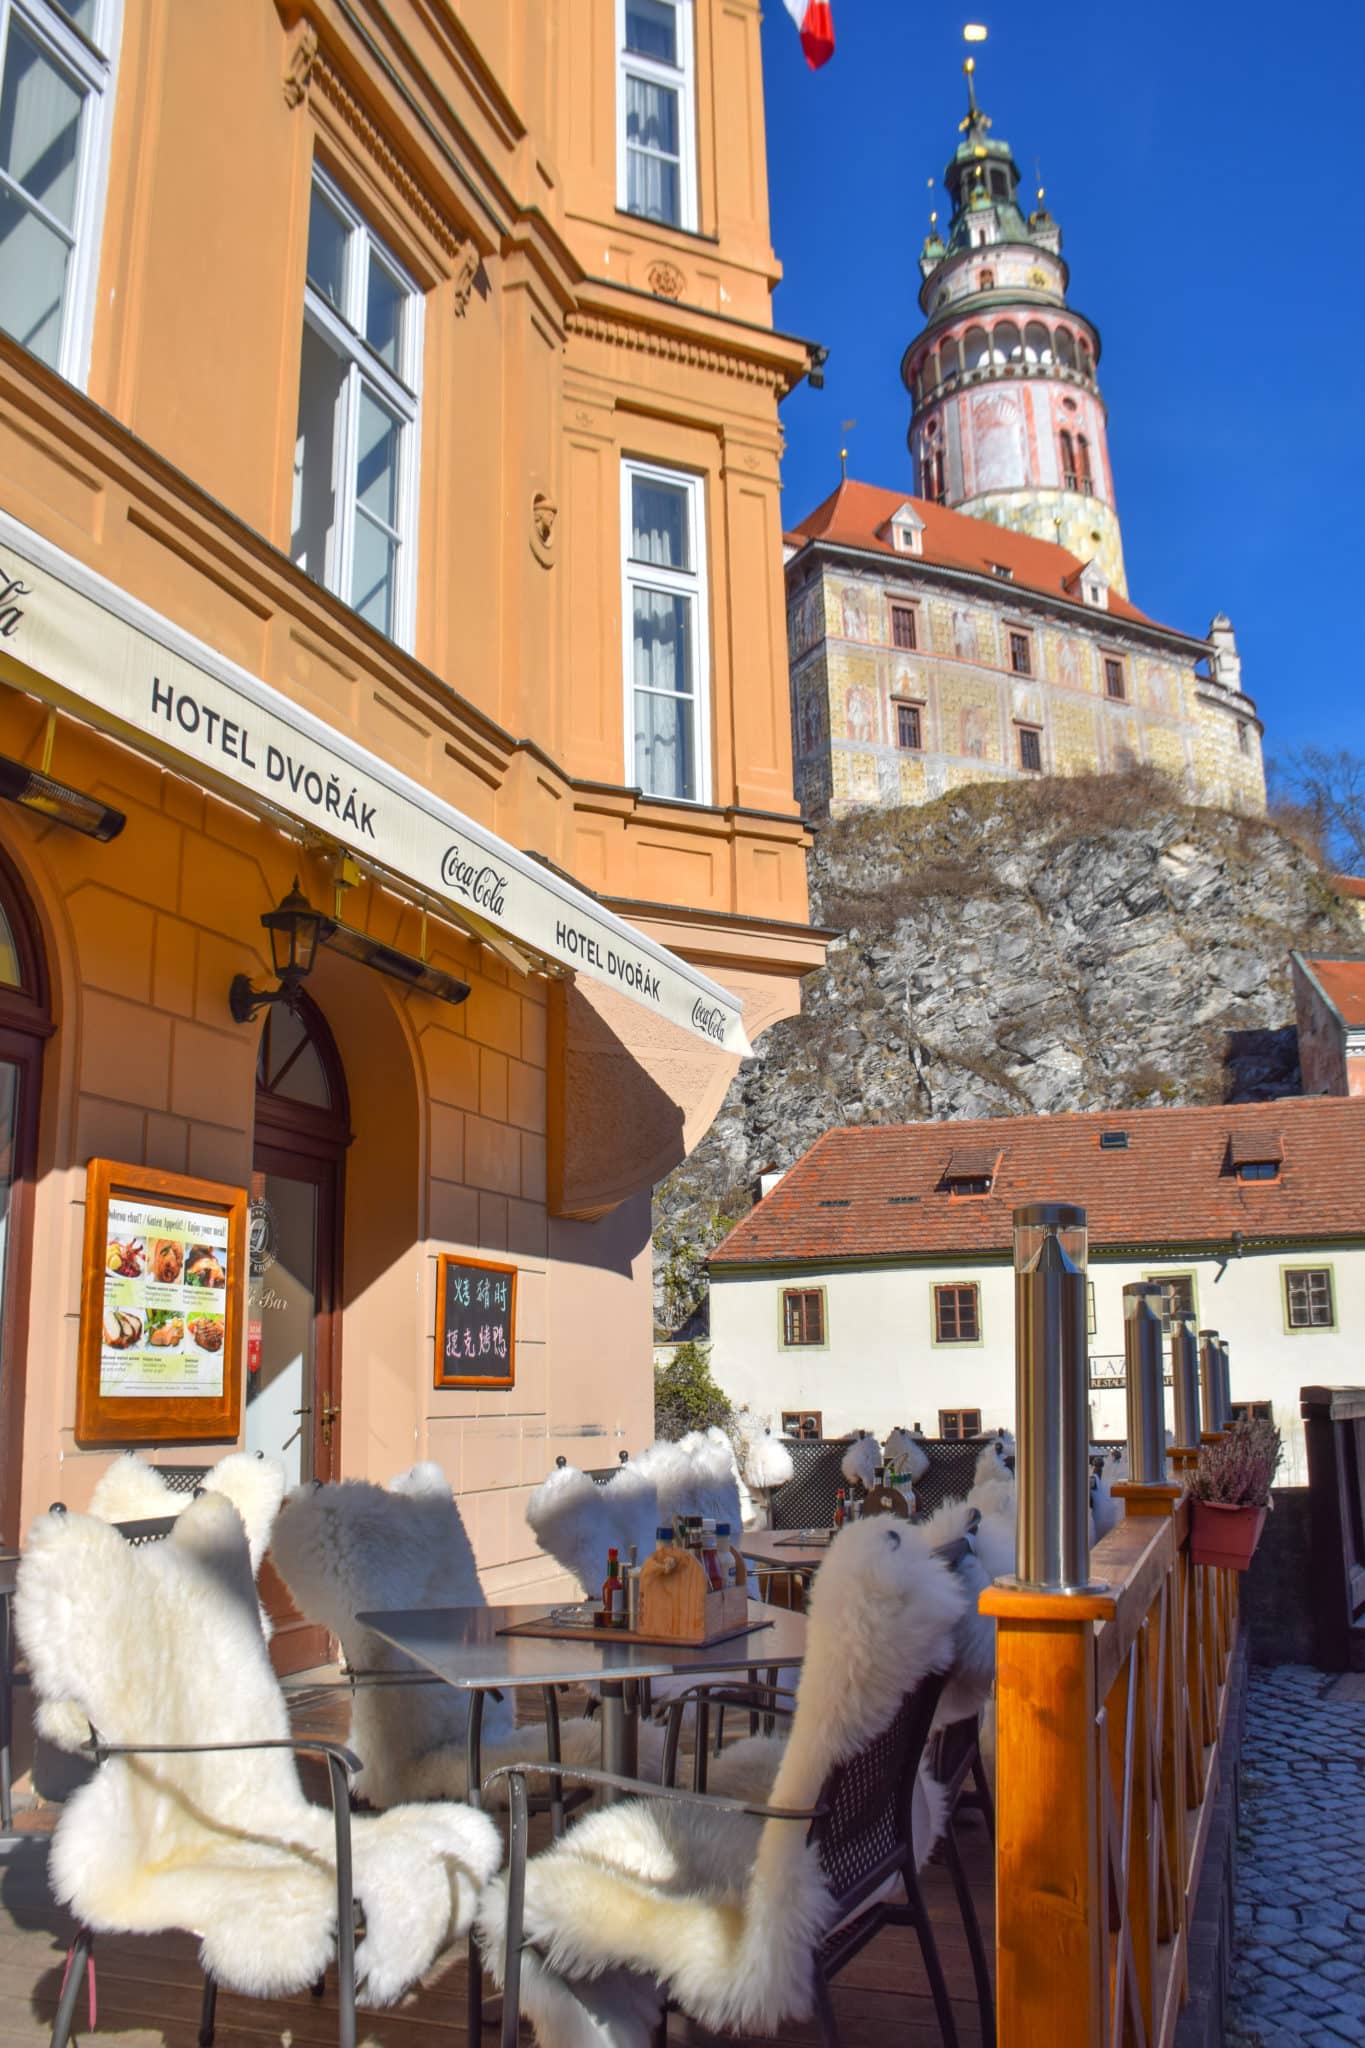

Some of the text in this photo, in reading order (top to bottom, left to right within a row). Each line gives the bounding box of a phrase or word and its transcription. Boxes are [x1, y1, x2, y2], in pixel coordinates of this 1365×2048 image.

[151, 677, 377, 840] HOTEL DVOŘÁK
[440, 845, 509, 918] Coca-Cola
[556, 920, 661, 1003] HOTEL DVOŘÁK
[691, 997, 727, 1042] Coca-Cola
[259, 1288, 288, 1310] Bar
